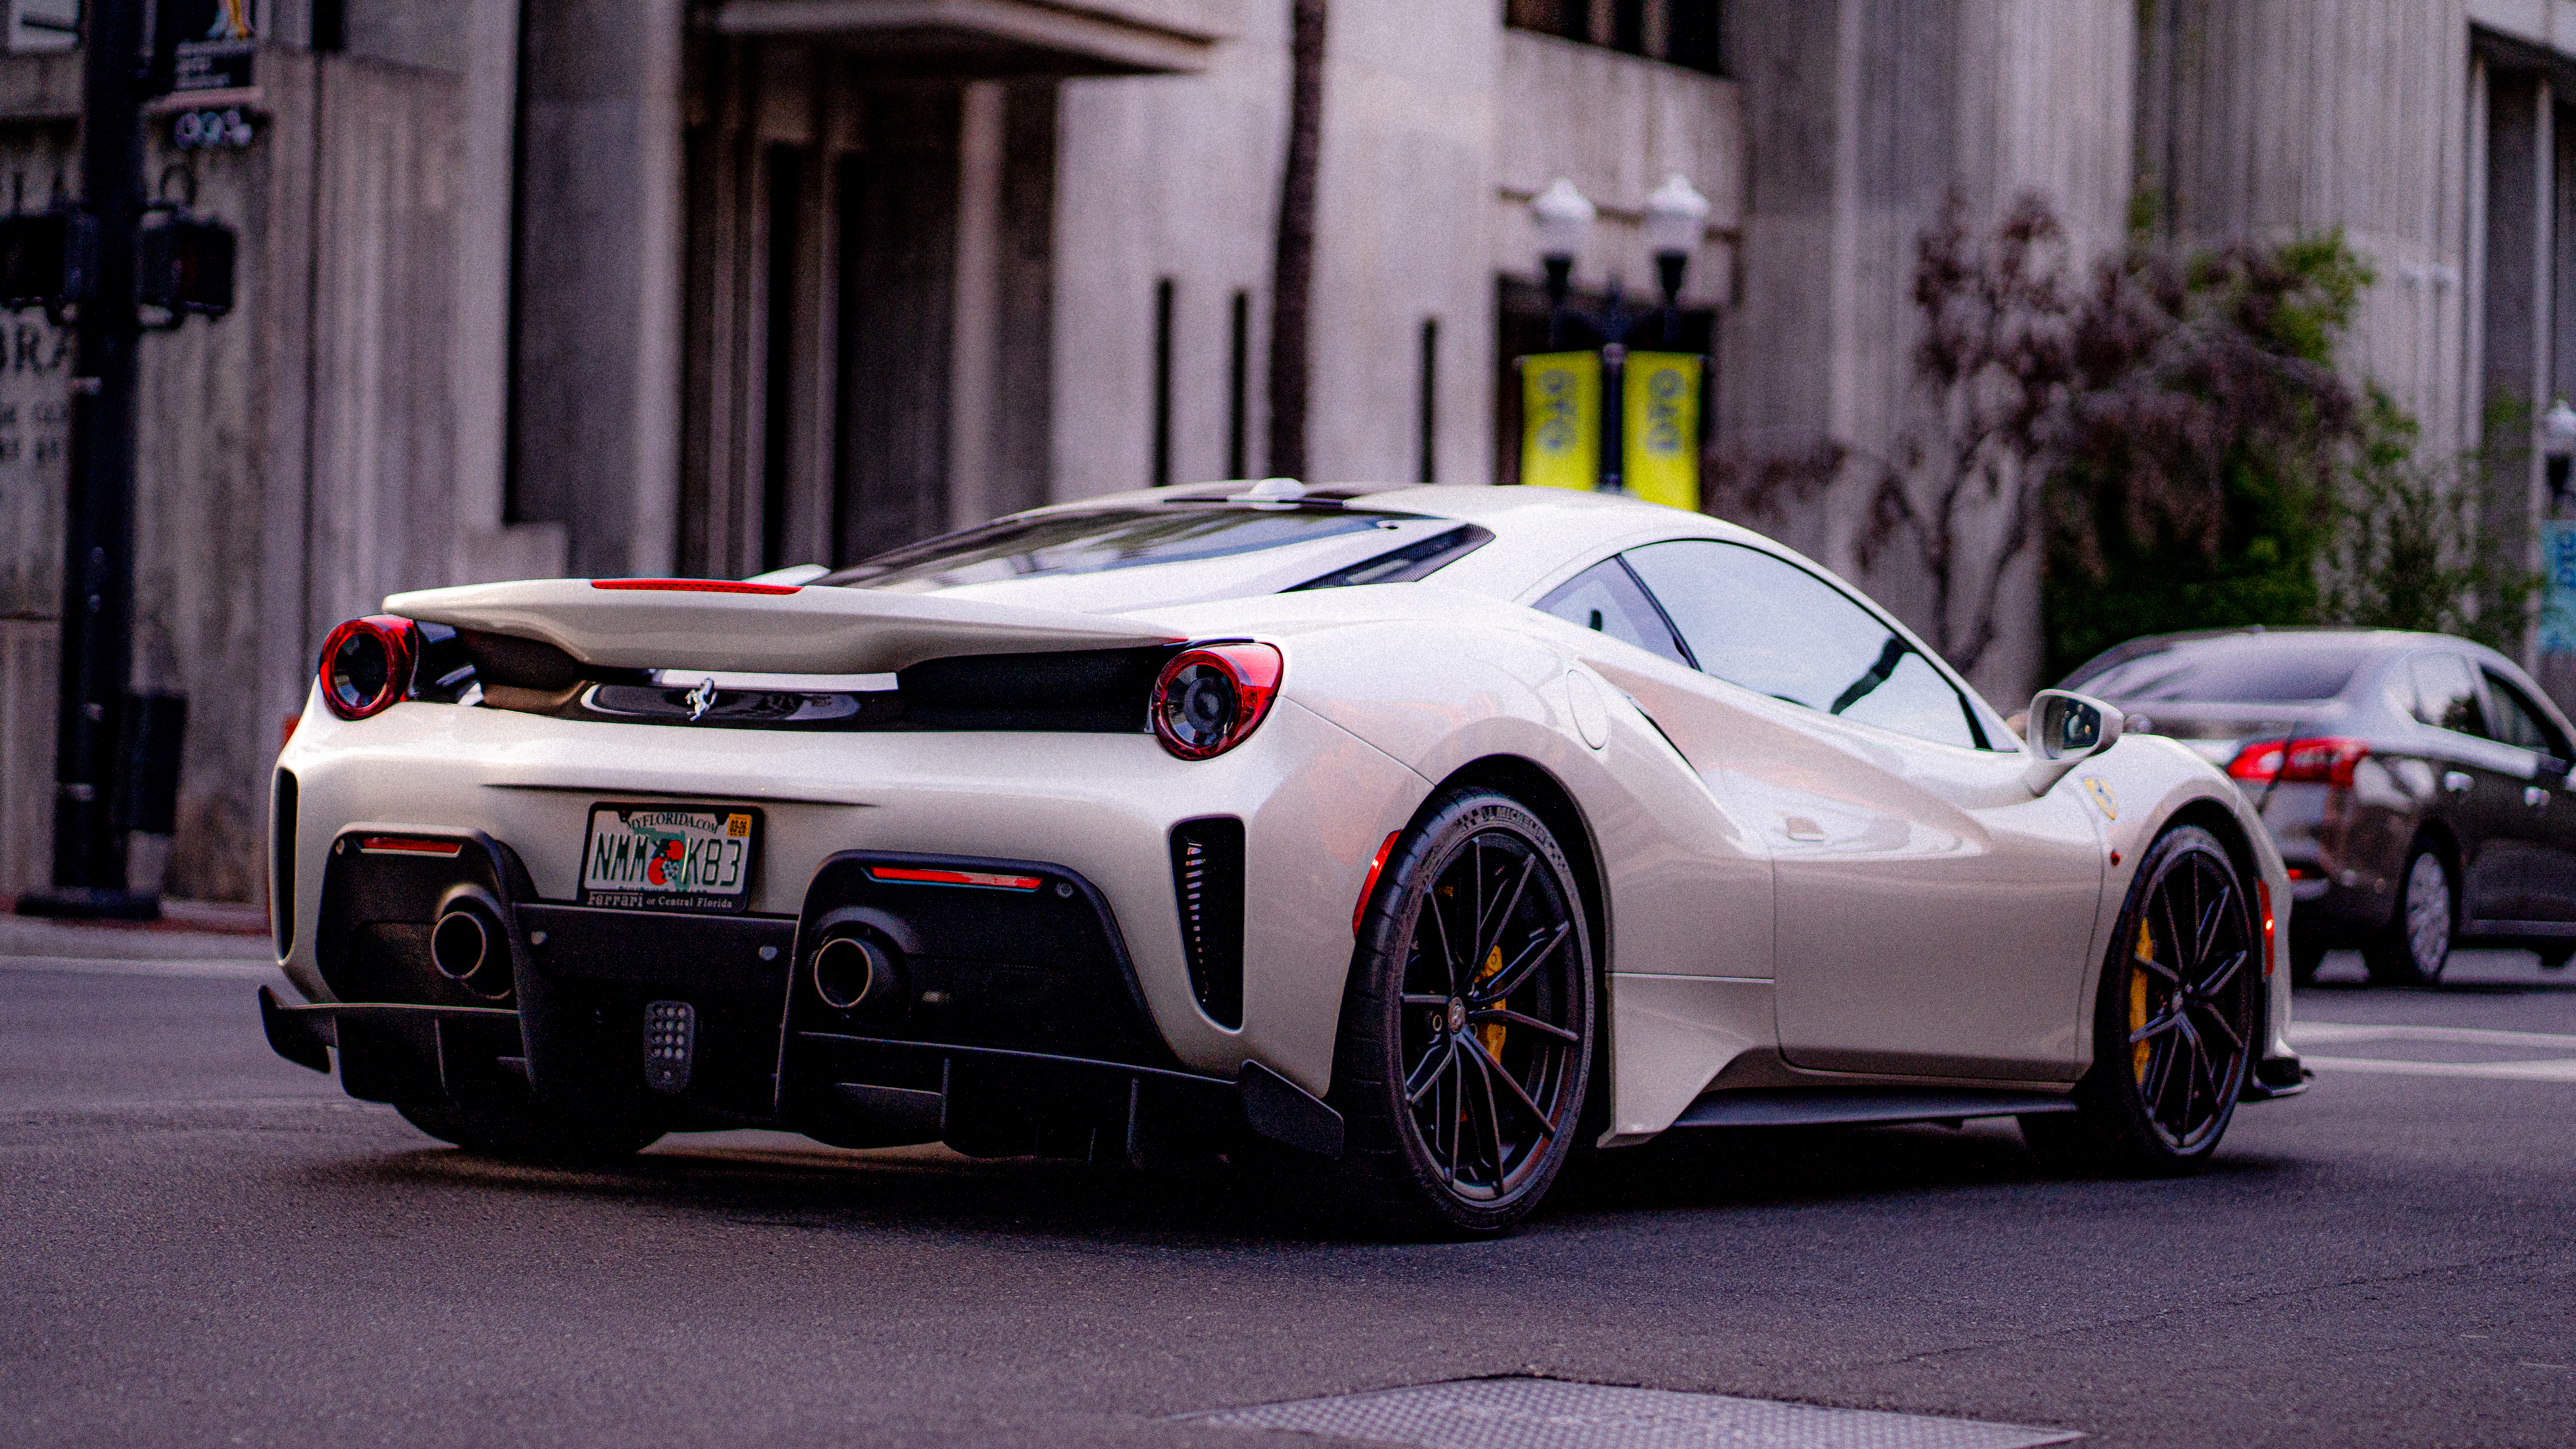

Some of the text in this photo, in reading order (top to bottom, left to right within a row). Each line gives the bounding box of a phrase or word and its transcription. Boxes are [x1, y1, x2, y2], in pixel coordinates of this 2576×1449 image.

[592, 833, 742, 887] NMM K83
[587, 891, 644, 907] Ferrari
[658, 896, 693, 906] Central
[697, 897, 732, 909] Florida
